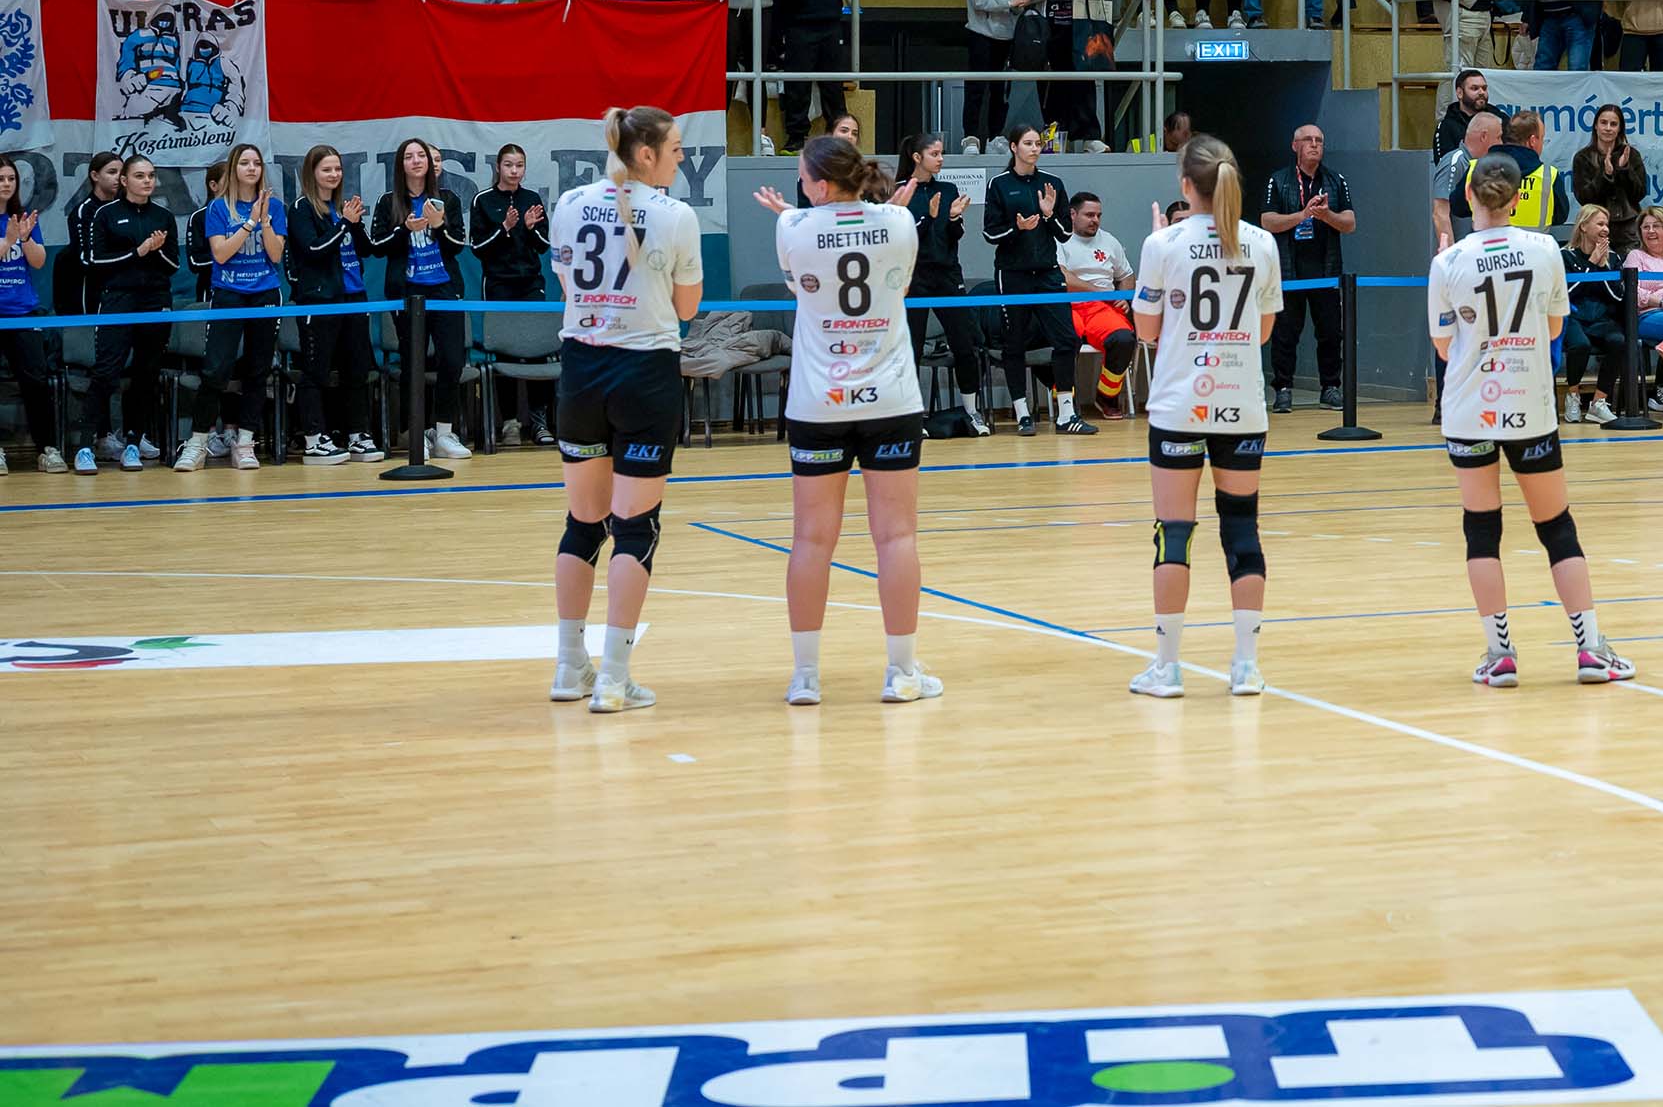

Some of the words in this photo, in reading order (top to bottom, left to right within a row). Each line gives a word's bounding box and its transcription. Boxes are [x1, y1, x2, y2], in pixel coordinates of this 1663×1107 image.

[1201, 43, 1242, 57] EXIT
[112, 127, 236, 156] Kozármisleny
[817, 228, 889, 249] BRETTNER
[573, 223, 647, 291] 37
[1476, 251, 1526, 273] BURSAC
[836, 251, 871, 317] 8
[1190, 265, 1255, 331] 67
[1474, 269, 1534, 337] 17
[850, 387, 878, 405] K3
[1214, 407, 1241, 423] K3
[1502, 412, 1527, 429] K3
